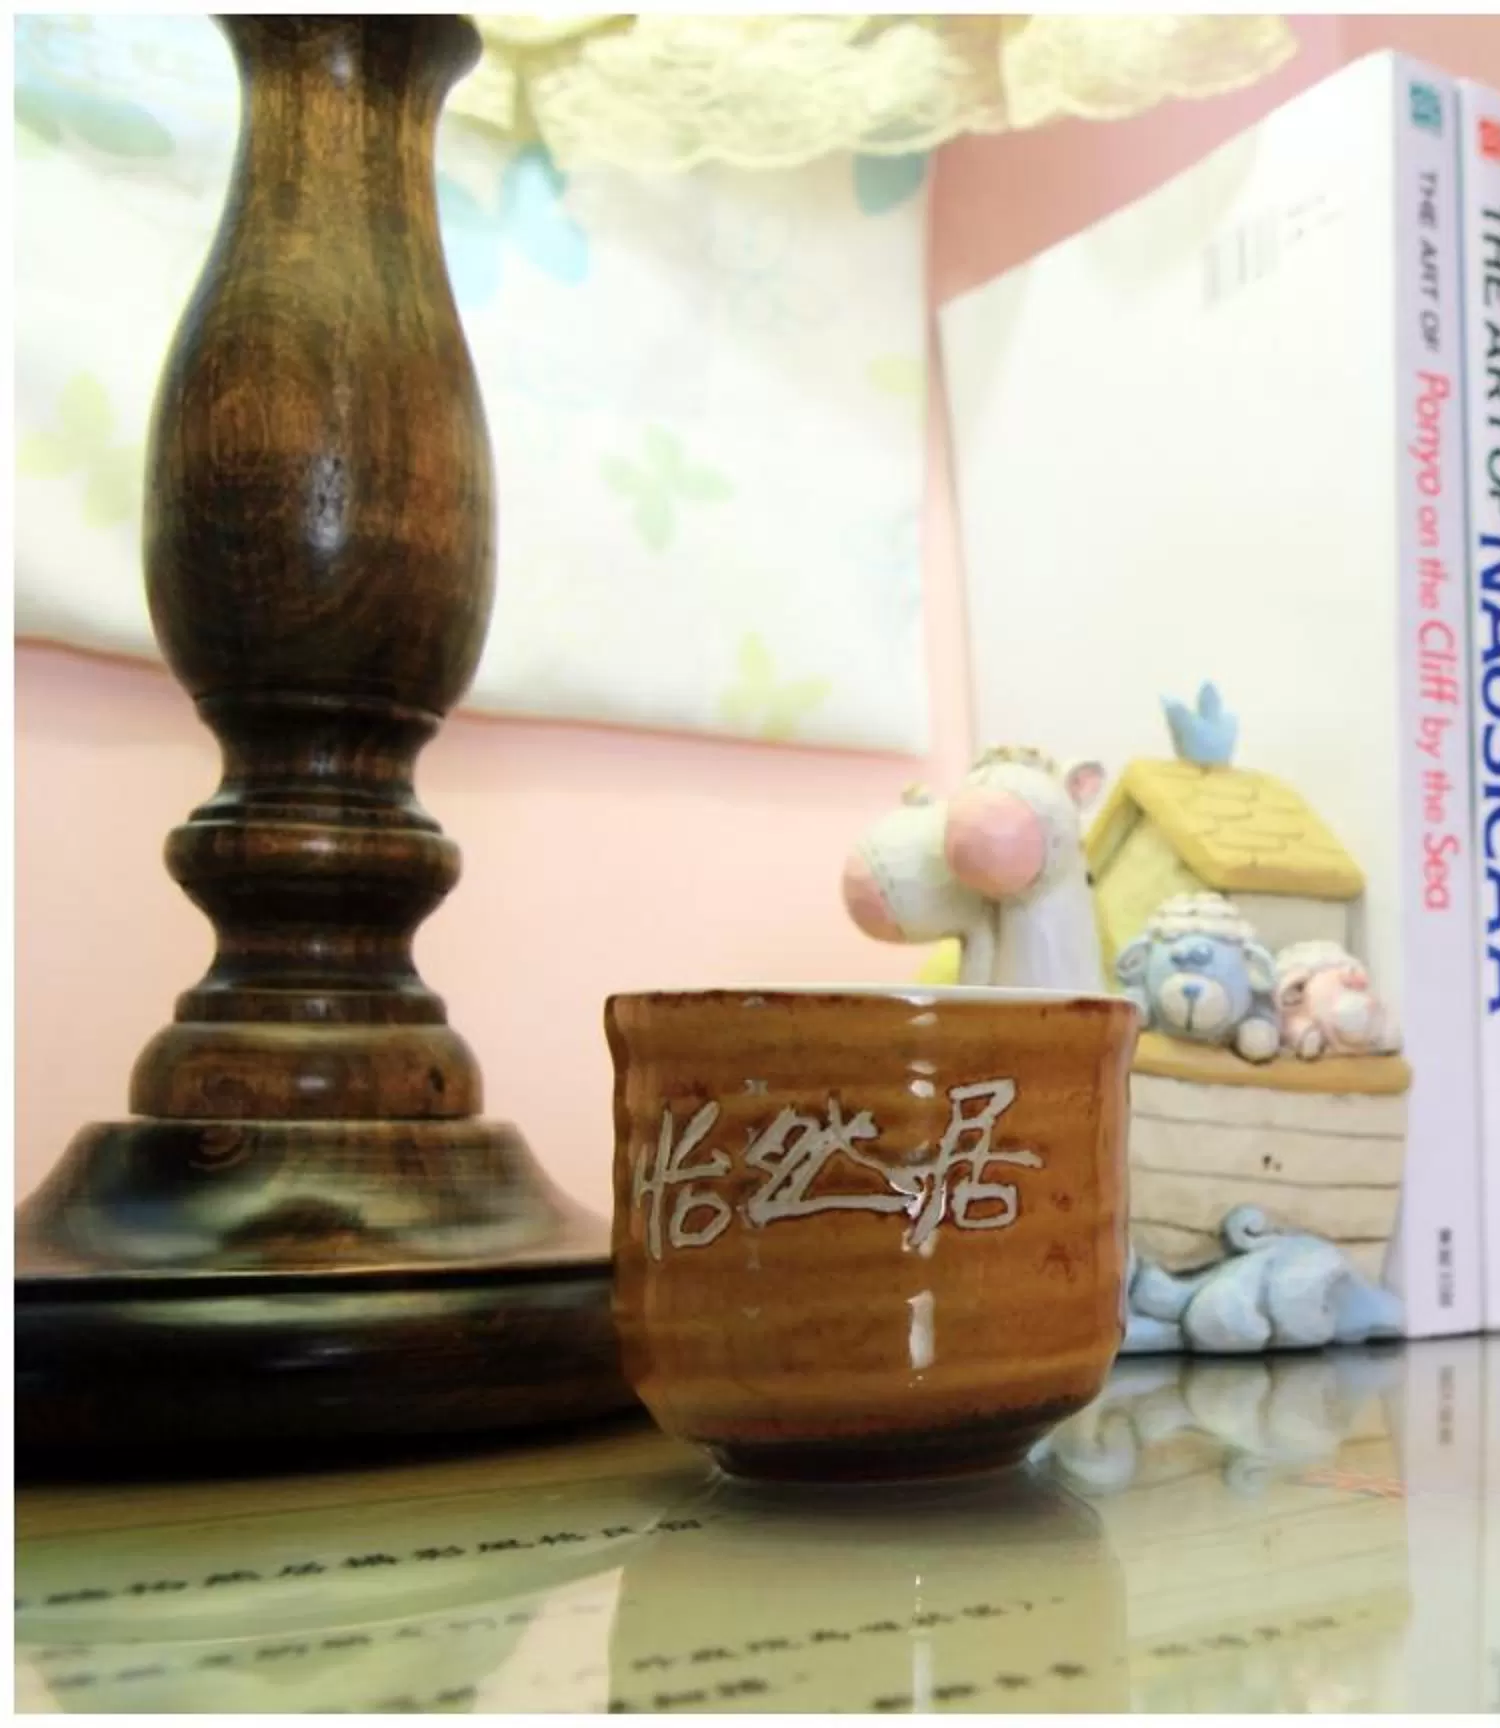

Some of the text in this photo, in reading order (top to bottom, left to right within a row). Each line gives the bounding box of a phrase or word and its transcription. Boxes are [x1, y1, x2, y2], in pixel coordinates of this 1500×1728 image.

[1417, 170, 1439, 230] THE
[1418, 239, 1440, 300] ART
[1418, 308, 1442, 354] OF
[1407, 370, 1452, 497] Ponyo
[1416, 504, 1441, 549] on
[1417, 556, 1450, 611] the
[1417, 618, 1459, 706] Cliff
[1415, 714, 1454, 758] by
[1422, 769, 1454, 824] the
[1422, 832, 1461, 912] Sea
